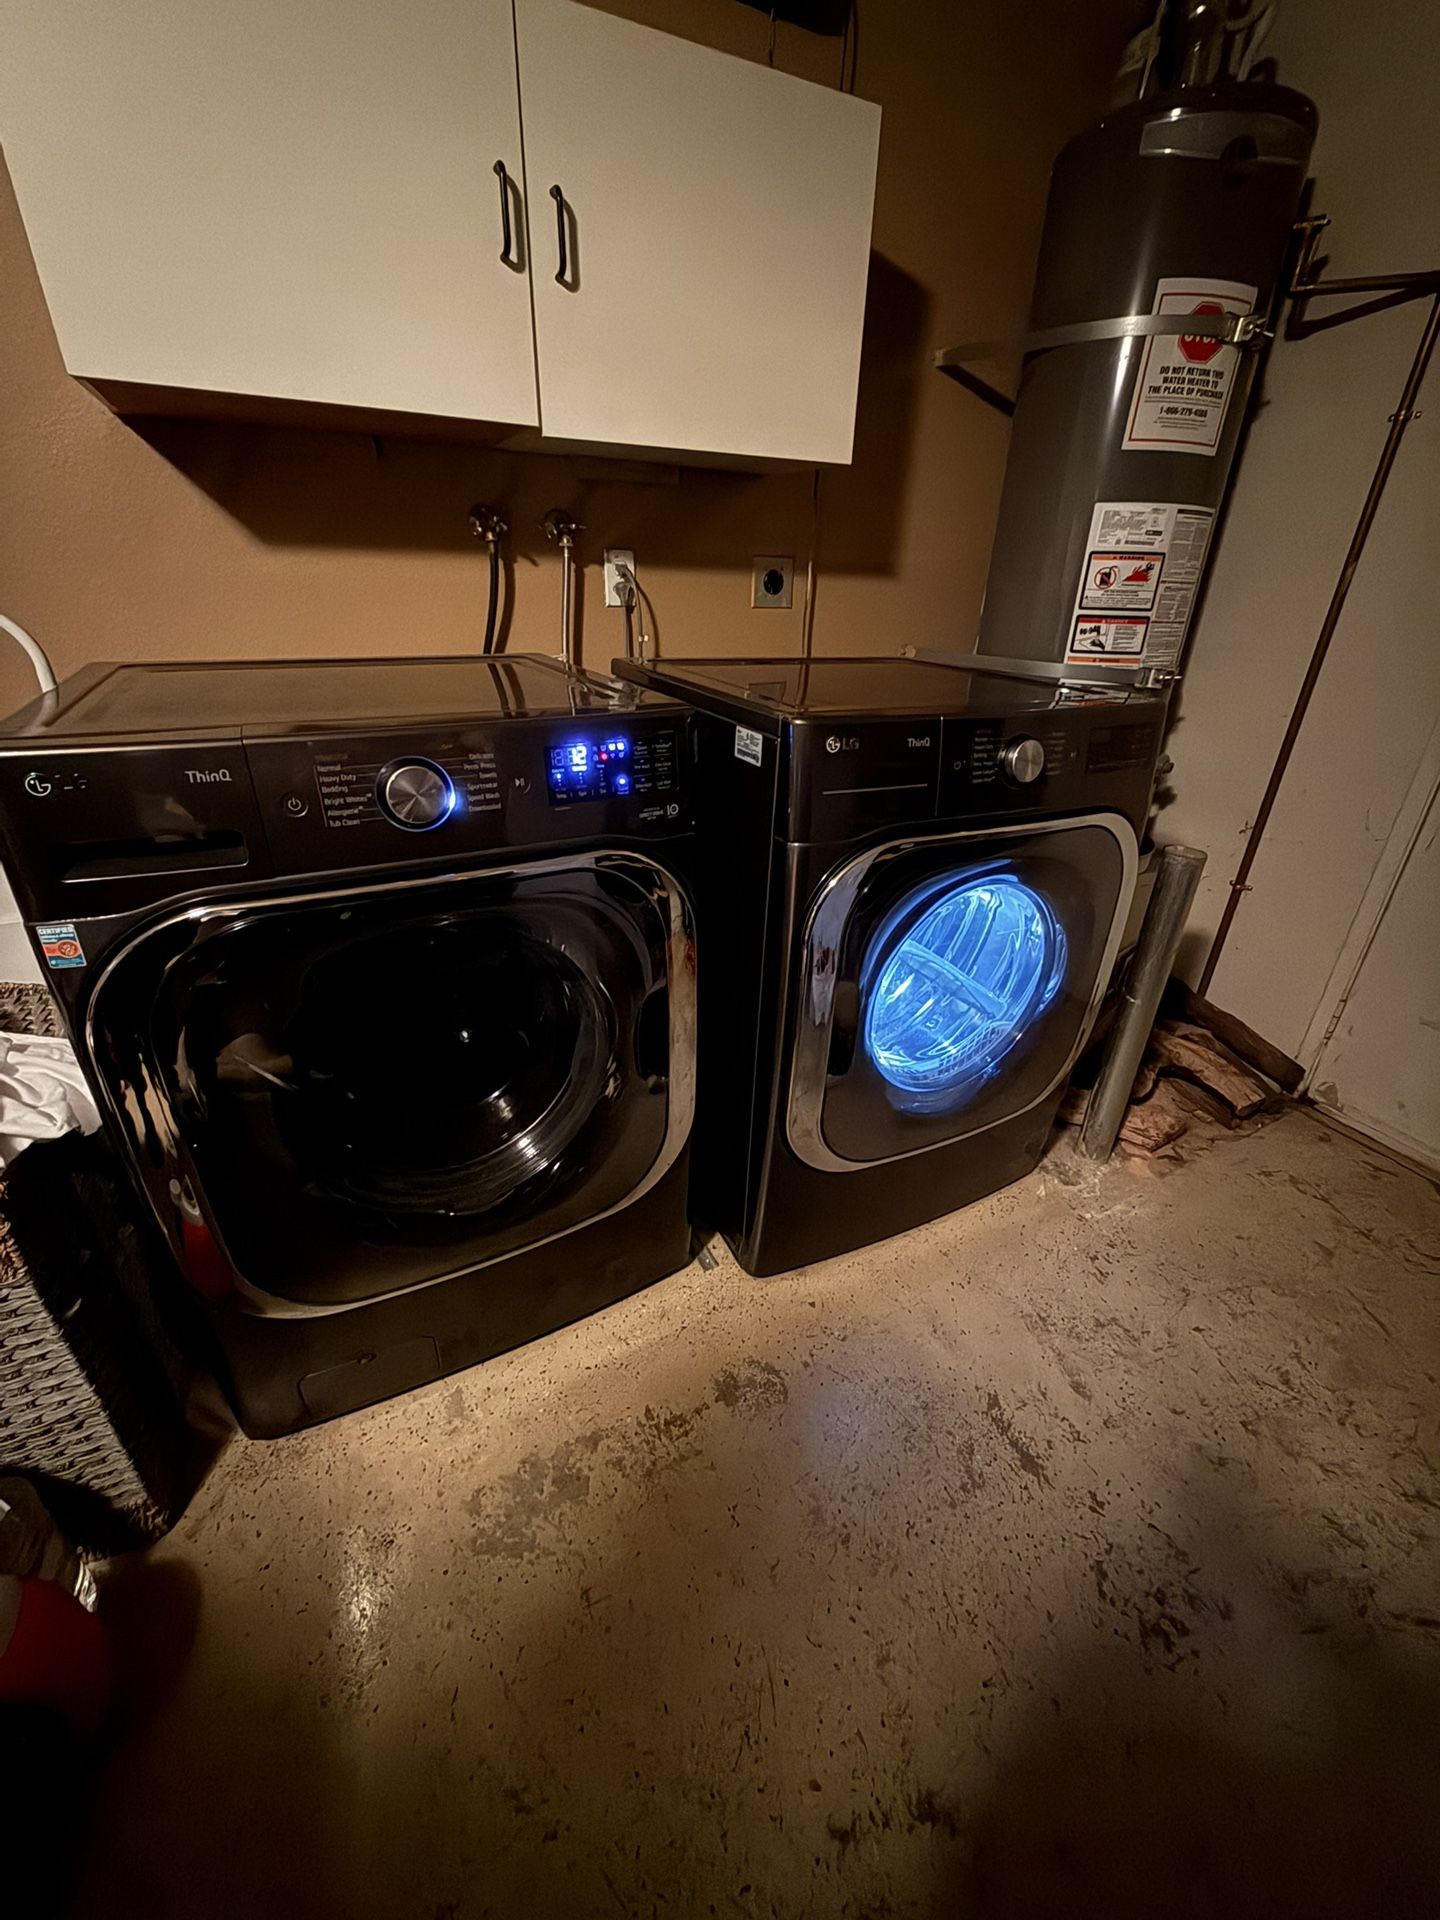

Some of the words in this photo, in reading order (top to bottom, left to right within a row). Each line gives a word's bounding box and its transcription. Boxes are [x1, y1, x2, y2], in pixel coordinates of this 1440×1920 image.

[1159, 366, 1170, 375] DO
[1171, 366, 1186, 375] NOT
[1162, 376, 1187, 385] WATER
[1187, 377, 1211, 388] HEATER
[1148, 385, 1162, 394] THE
[1162, 386, 1186, 395] PLACE
[1186, 387, 1195, 396] OF
[907, 736, 931, 748] ThinQ
[184, 768, 232, 784] ThinQ
[319, 775, 340, 783] Heavy
[340, 774, 357, 782] Duty
[667, 803, 679, 815] 10
